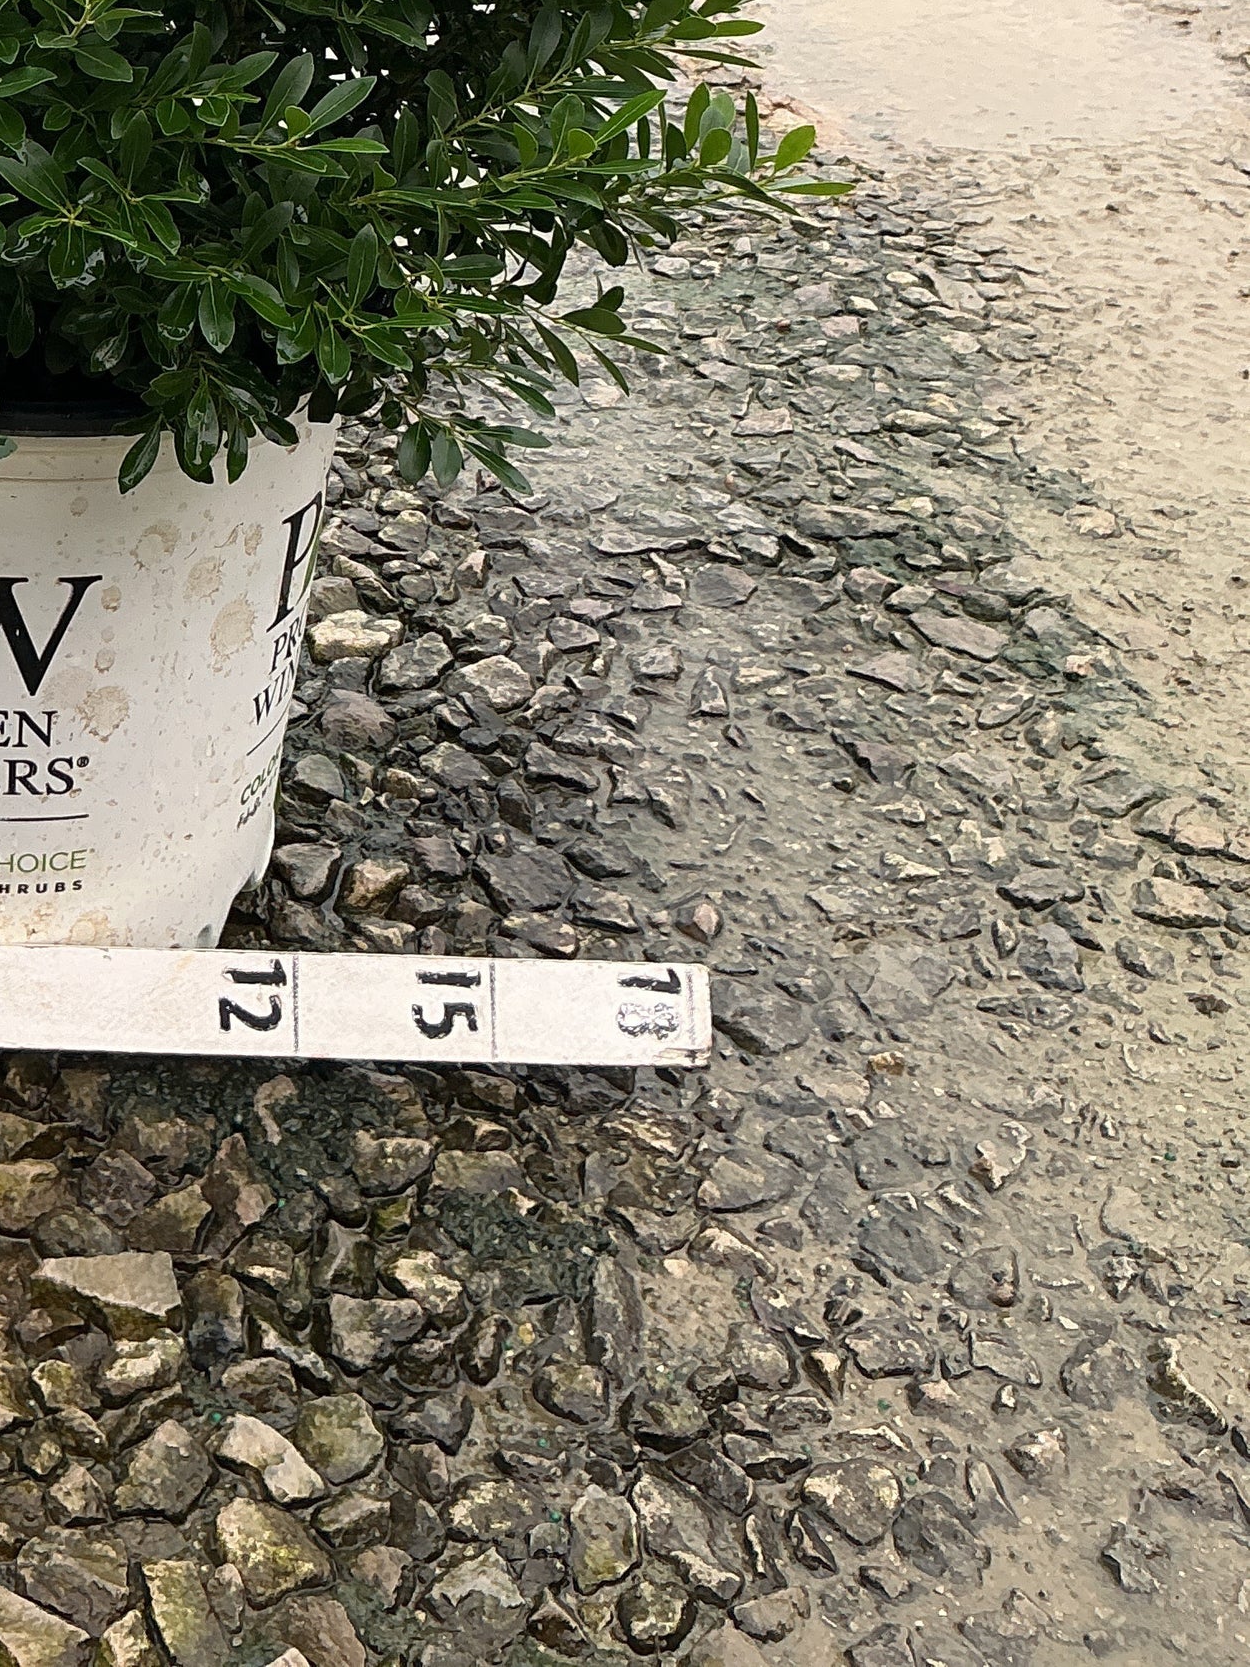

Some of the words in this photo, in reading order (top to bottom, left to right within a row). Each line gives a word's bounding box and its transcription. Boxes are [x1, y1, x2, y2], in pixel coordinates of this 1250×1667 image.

[218, 958, 287, 1034] 12
[411, 967, 481, 1040] 15
[616, 968, 682, 1041] 18
